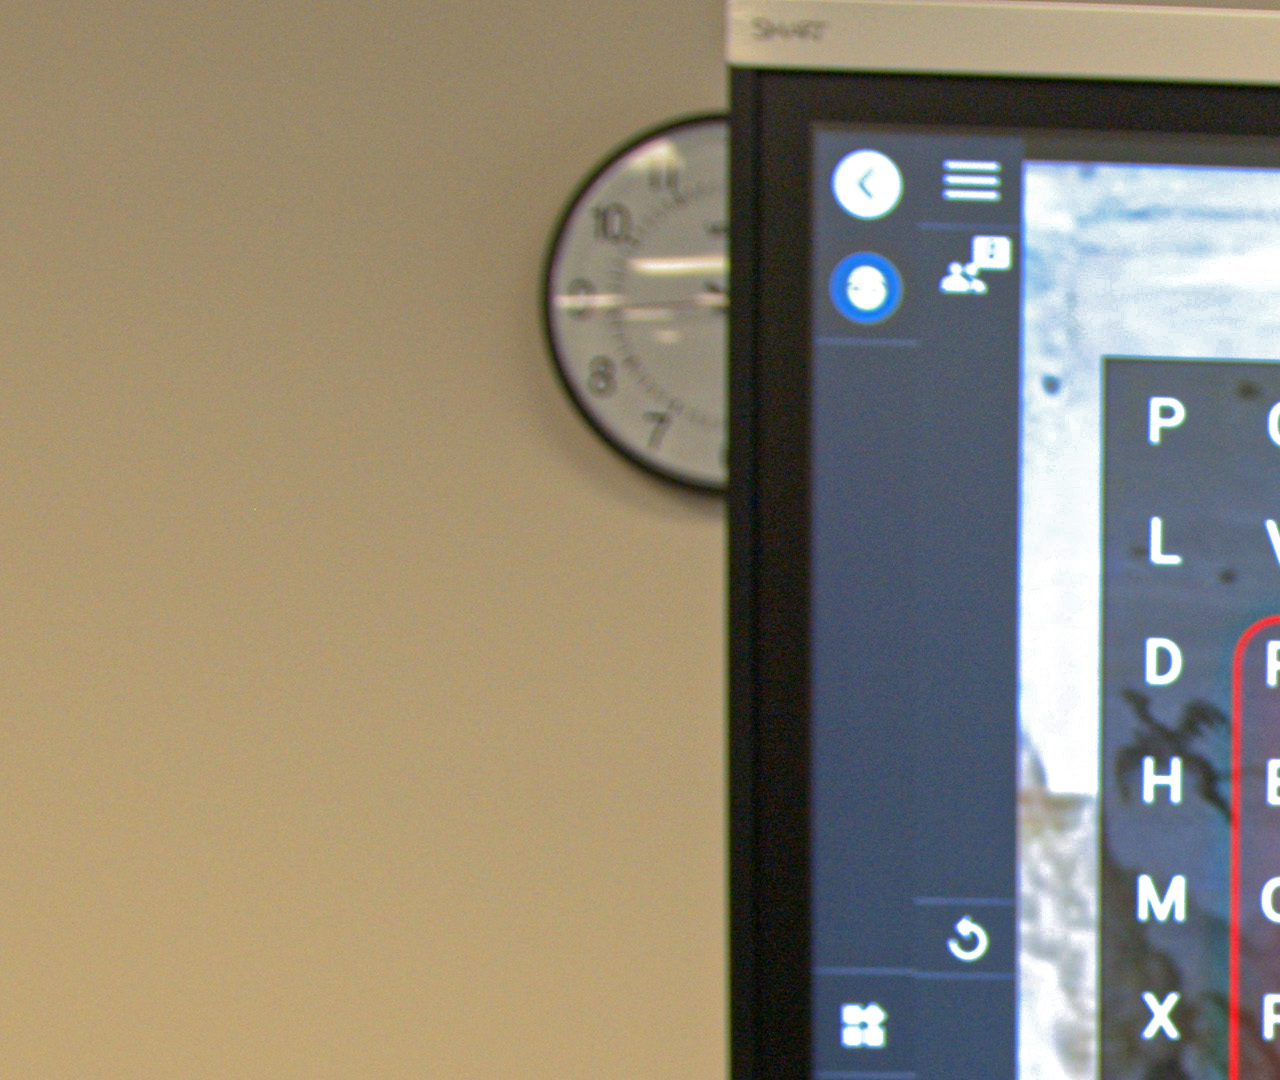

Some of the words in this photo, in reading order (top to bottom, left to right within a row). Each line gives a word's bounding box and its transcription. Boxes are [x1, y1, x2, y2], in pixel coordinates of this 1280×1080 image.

[592, 203, 633, 241] 10
[588, 355, 617, 397] 8
[642, 410, 673, 449] 7
[1148, 396, 1186, 444] P
[1149, 515, 1183, 566] L
[1145, 636, 1183, 686] D
[1142, 756, 1182, 804] H
[1137, 873, 1187, 922] M
[1142, 991, 1179, 1040] X
